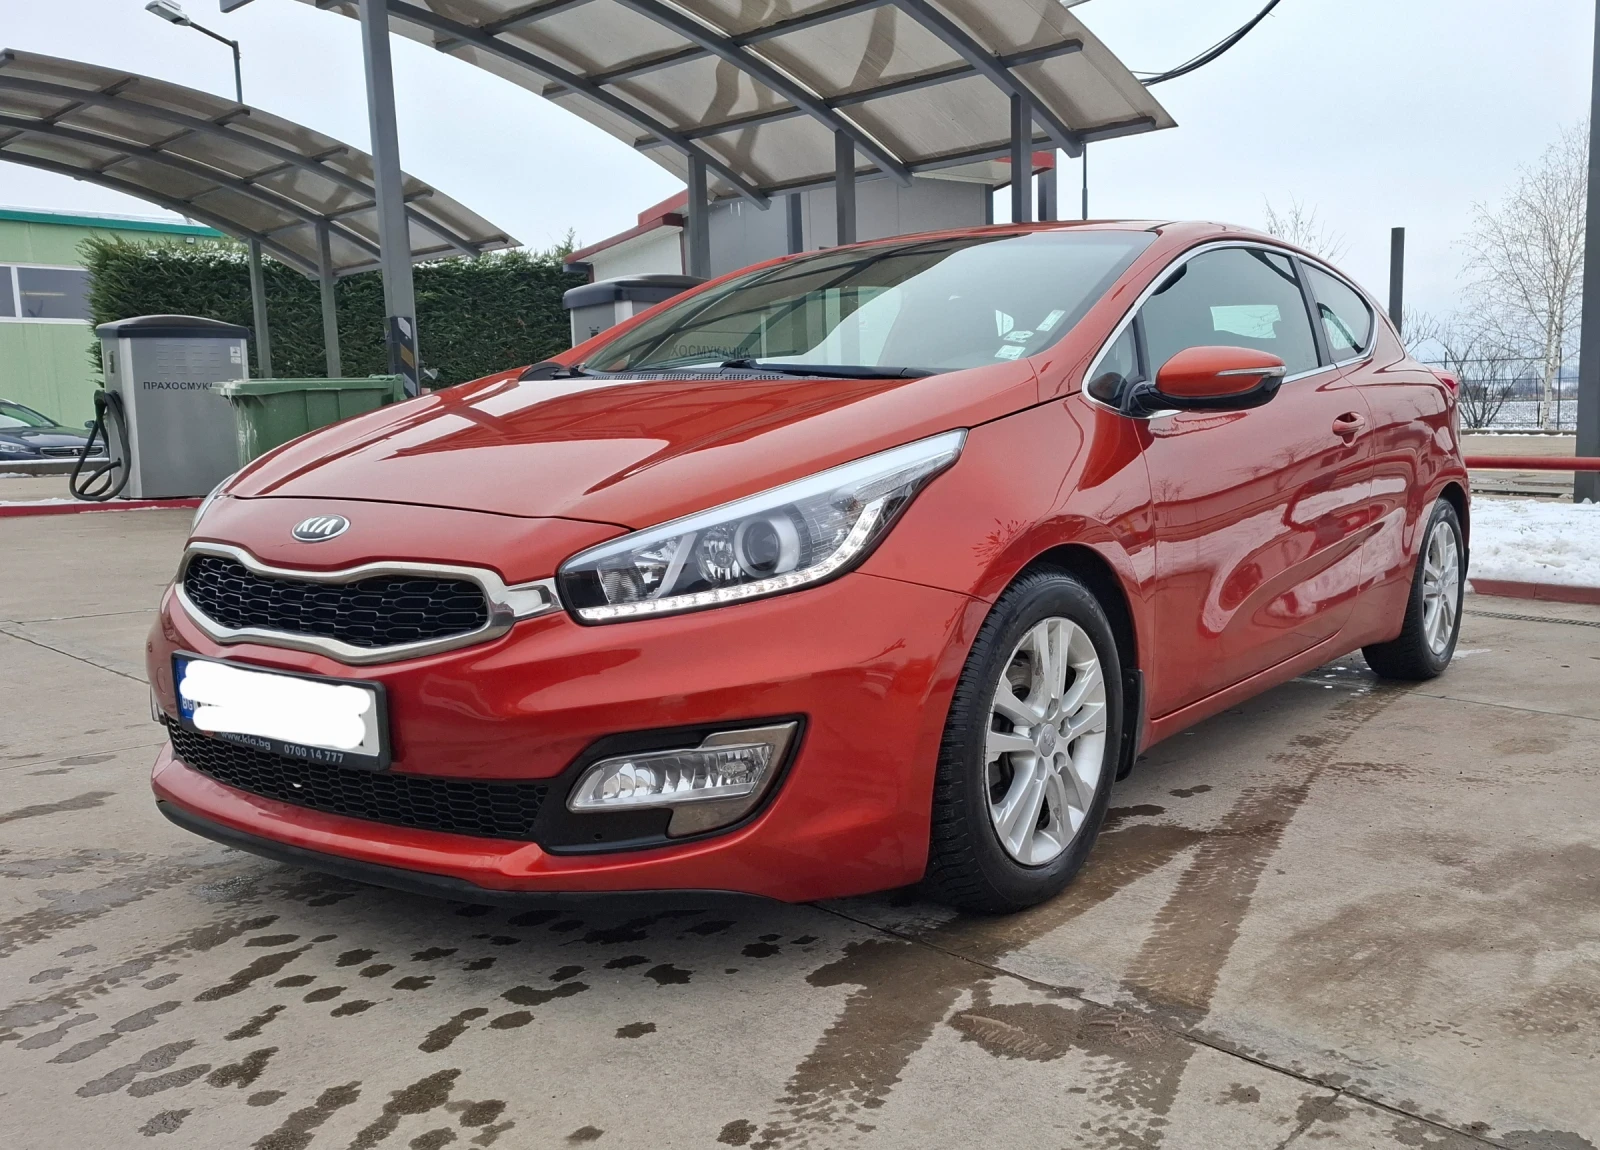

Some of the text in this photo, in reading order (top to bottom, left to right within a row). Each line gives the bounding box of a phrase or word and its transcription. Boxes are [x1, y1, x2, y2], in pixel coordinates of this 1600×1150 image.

[143, 381, 212, 390] ПРАХОСМУК
[296, 517, 338, 535] KIA
[221, 731, 271, 751] www.kia.bg
[284, 744, 307, 757] 0700
[310, 749, 323, 760] 14
[324, 751, 344, 763] 777
